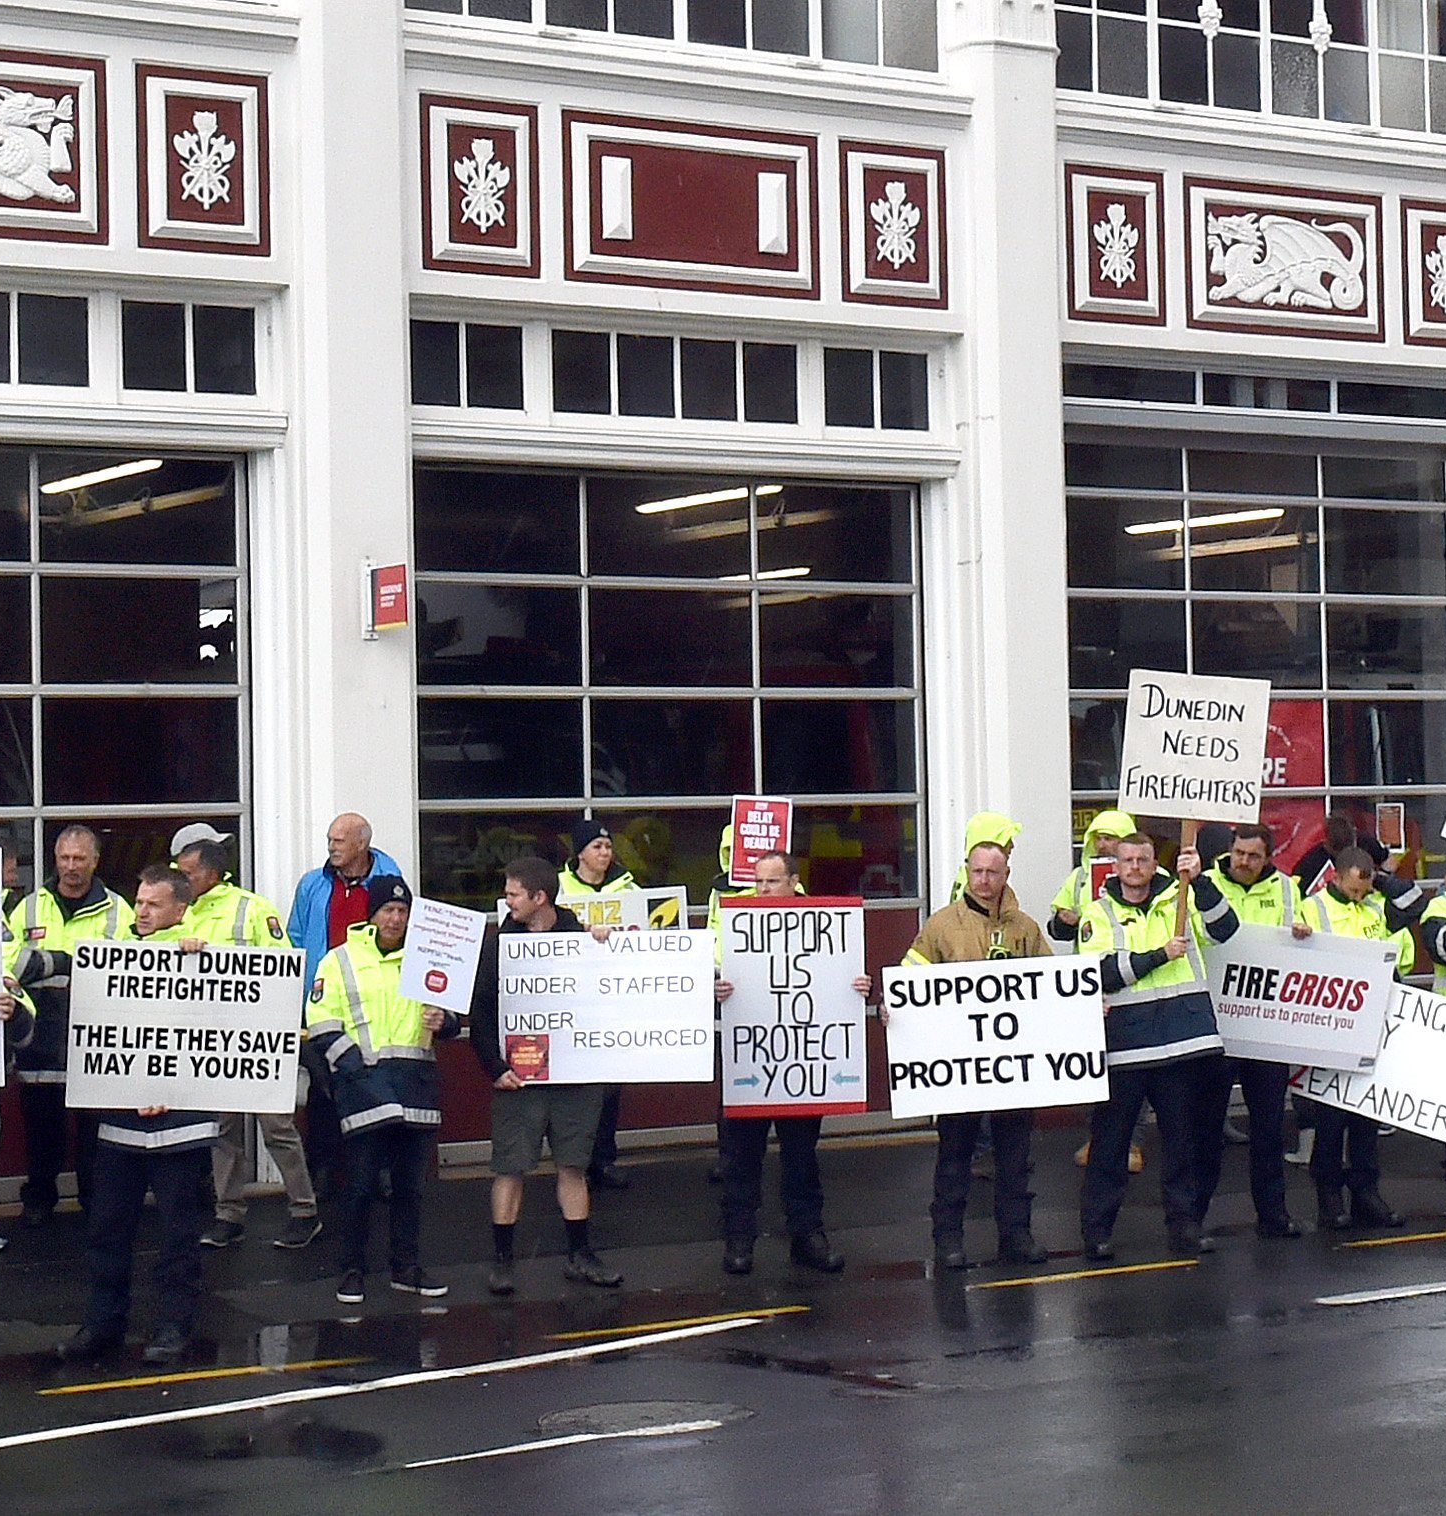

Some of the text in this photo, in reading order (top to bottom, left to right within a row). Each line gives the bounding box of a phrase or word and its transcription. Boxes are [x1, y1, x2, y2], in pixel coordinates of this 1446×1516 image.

[1140, 683, 1245, 723] DUNEDIN
[1162, 729, 1240, 762] NEEDS
[1125, 765, 1256, 807] FIREFIGHTERS
[508, 935, 693, 960] UNDER VALUED
[731, 911, 852, 955] SUPPORT
[76, 946, 302, 978] SUPPORT DUNEDIN
[769, 953, 812, 989] US
[107, 975, 262, 1003] FIREFIGHTERS
[505, 976, 695, 995] UNDER STAFFED
[889, 967, 1100, 1009] SUPPORT US
[1222, 963, 1370, 1012] FIRE CRISIS
[505, 1012, 574, 1032] UNDER
[769, 990, 814, 1025] TO
[1217, 1001, 1355, 1031] support us to protect you
[72, 1024, 297, 1055] THE LIFE THEY SAVE
[573, 1029, 708, 1049] RESOURCED
[733, 1022, 856, 1063] PROTECT
[967, 1012, 1019, 1042] TO
[84, 1052, 136, 1076] MAY
[147, 1055, 178, 1077] BE
[762, 1063, 828, 1098] YOU
[890, 1050, 1106, 1091] PROTECT YOU
